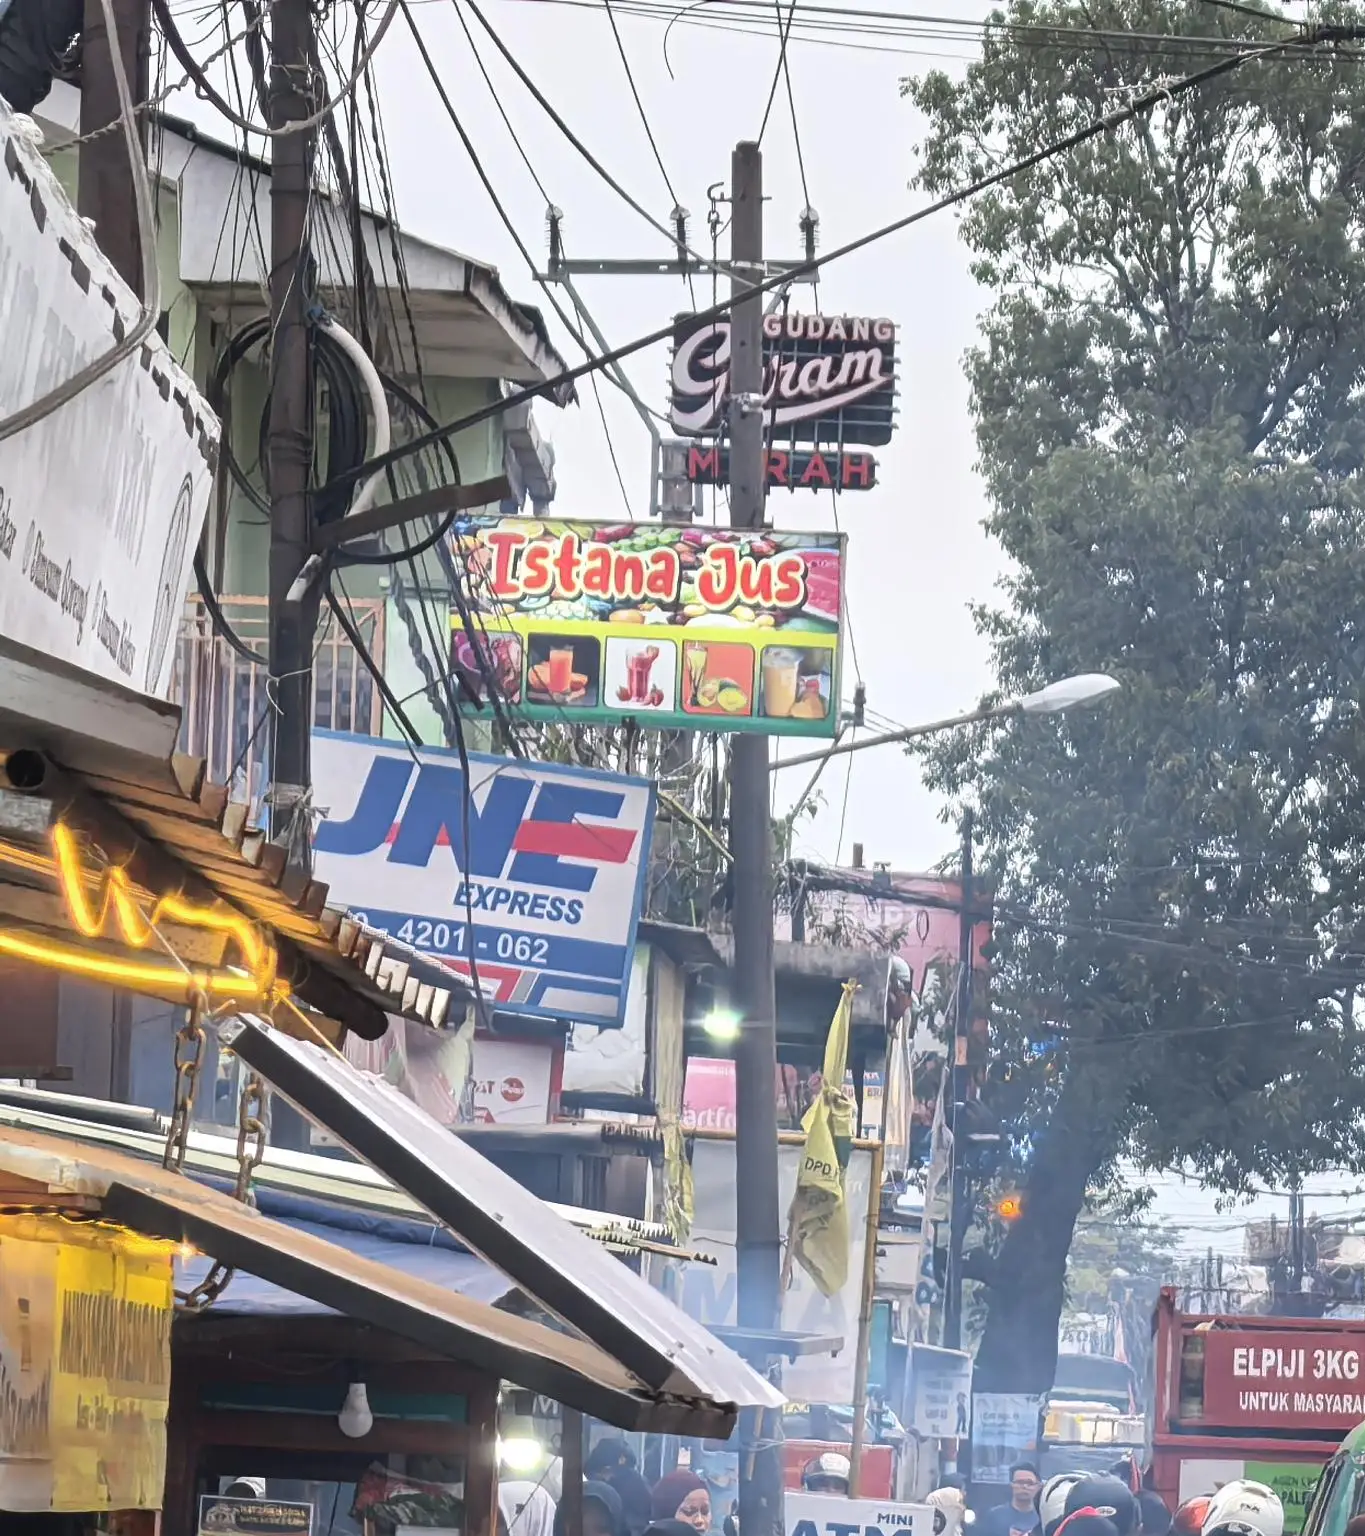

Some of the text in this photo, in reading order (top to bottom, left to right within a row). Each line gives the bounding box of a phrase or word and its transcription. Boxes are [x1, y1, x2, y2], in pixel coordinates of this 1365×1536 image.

[763, 314, 893, 341] GUDANG
[671, 322, 893, 431] Gram
[688, 447, 869, 485] MRAH
[485, 530, 803, 606] Istana Jus
[312, 755, 638, 892] JNE
[453, 881, 584, 925] EXPRESS
[397, 918, 465, 950] 4201
[496, 931, 549, 963] 062
[1233, 1347, 1305, 1379] ELPIJI
[1312, 1349, 1359, 1380] 3KG
[1239, 1391, 1289, 1412] UNTUK
[877, 1512, 913, 1526] MINI
